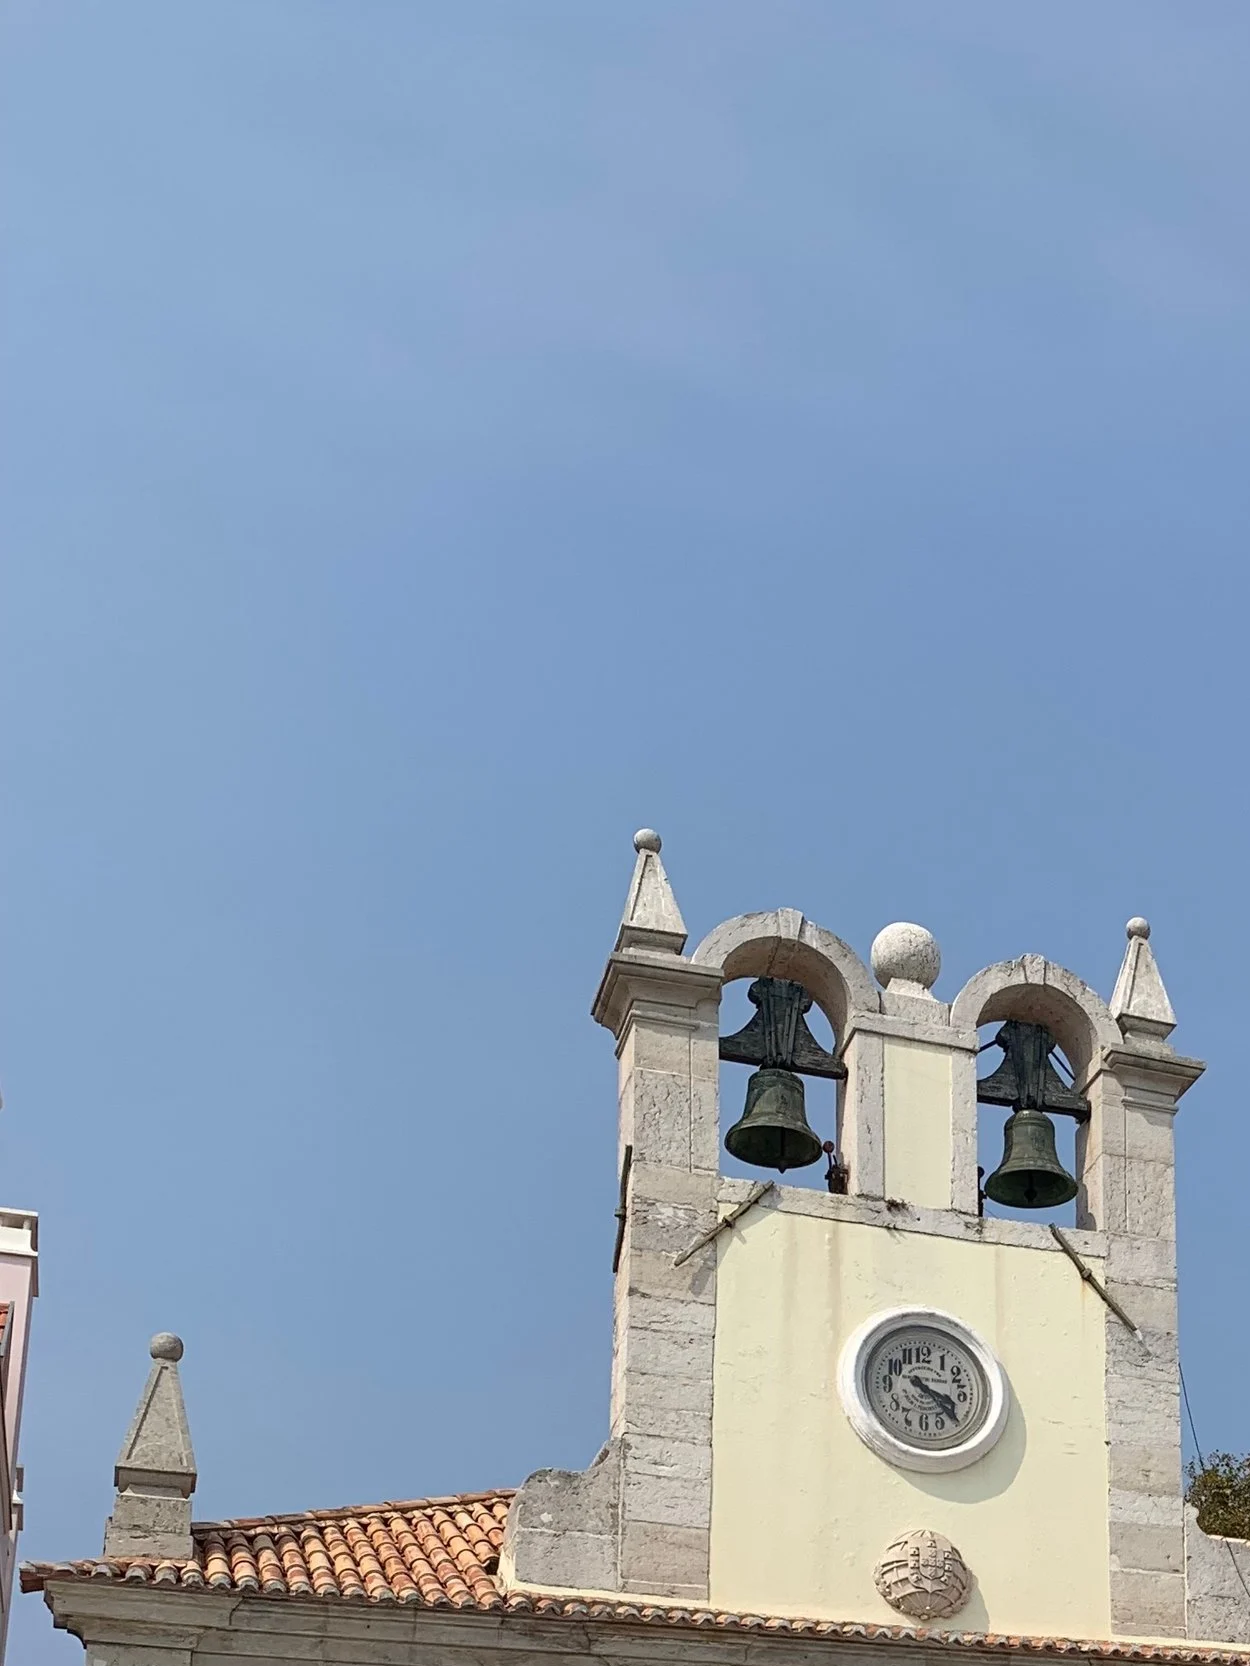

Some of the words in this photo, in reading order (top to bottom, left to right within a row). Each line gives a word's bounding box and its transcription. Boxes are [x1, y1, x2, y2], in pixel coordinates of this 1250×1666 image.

[915, 1346, 931, 1364] 12
[939, 1354, 946, 1371] 1
[888, 1358, 902, 1377] 10
[950, 1365, 962, 1384] 2
[882, 1375, 893, 1393] 9
[956, 1384, 968, 1403] 3
[889, 1393, 900, 1412] 8
[901, 1407, 912, 1427] 7
[919, 1414, 929, 1431] 6
[935, 1411, 945, 1430] 5
